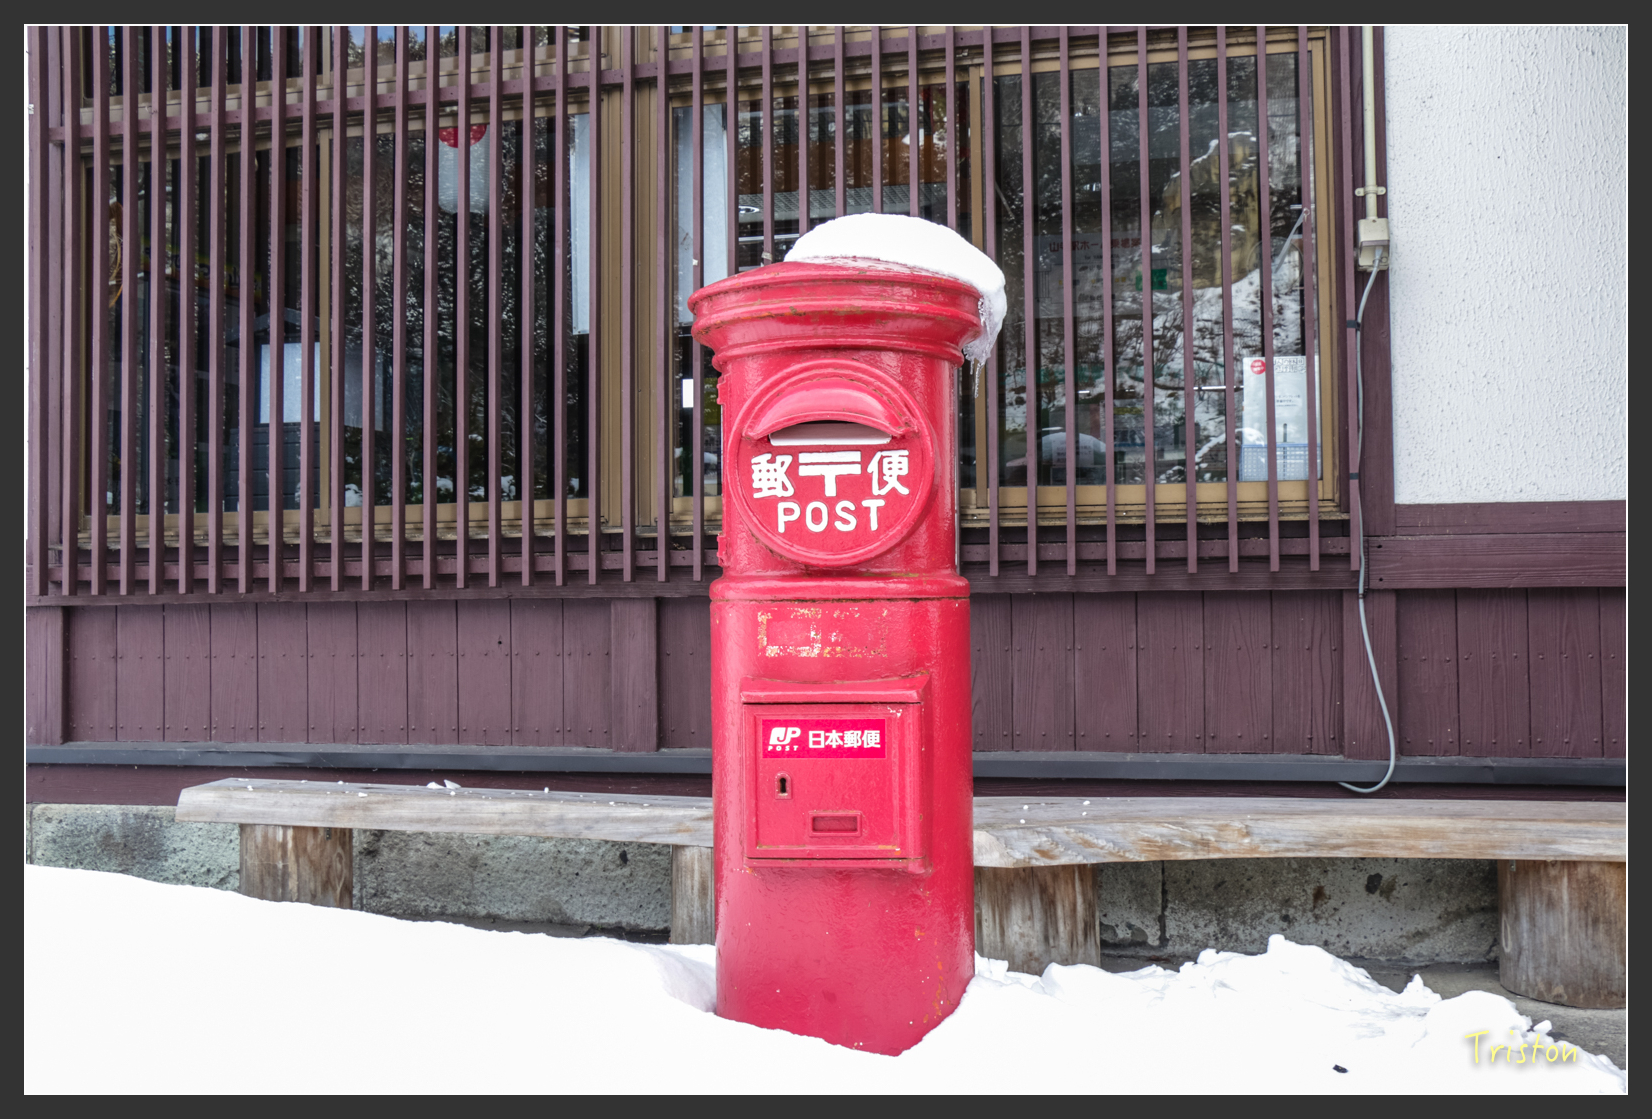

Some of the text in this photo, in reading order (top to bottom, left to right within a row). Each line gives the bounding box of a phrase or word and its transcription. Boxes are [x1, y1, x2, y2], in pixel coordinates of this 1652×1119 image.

[777, 499, 886, 533] POST
[769, 727, 801, 745] JP
[808, 729, 881, 748] 日本郵便
